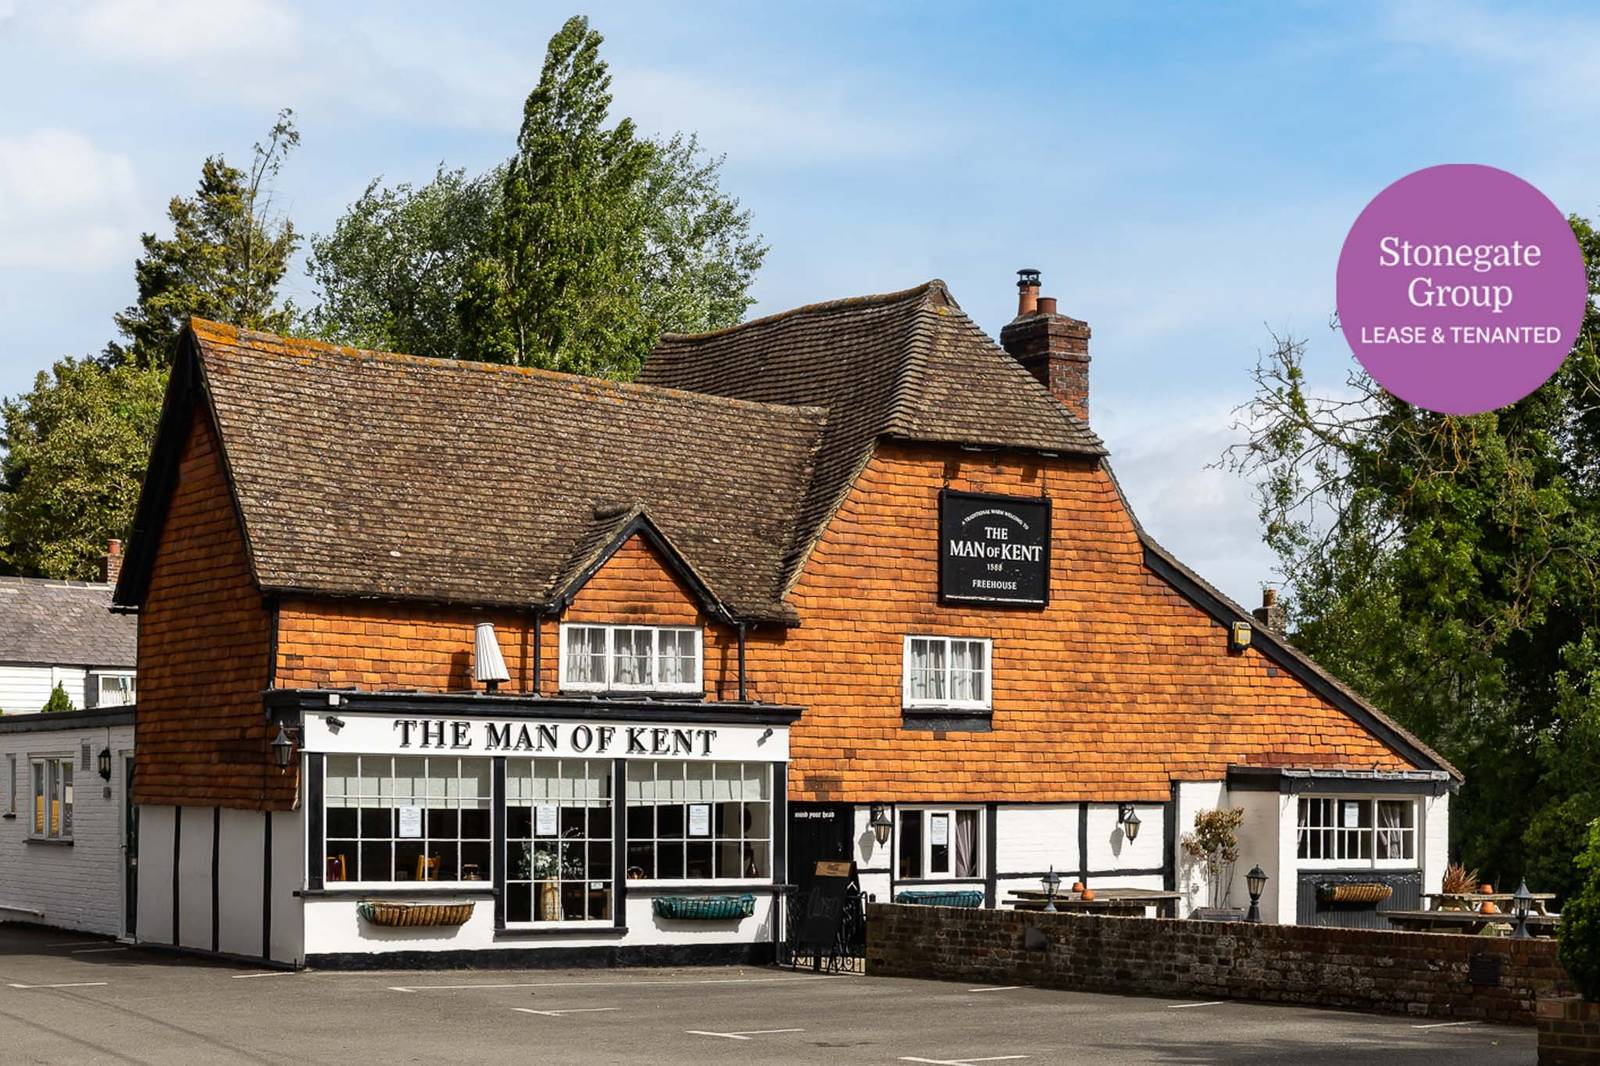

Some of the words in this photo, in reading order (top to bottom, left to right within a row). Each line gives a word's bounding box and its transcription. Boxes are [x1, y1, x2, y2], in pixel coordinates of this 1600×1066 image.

[964, 509, 990, 522] TRADITIONAL
[1004, 511, 1023, 525] WELCOME
[984, 526, 1009, 540] THE
[949, 539, 986, 558] MAN
[986, 546, 1001, 558] OF
[1001, 543, 1043, 562] KENT
[972, 579, 1017, 590] FREEHOUSE
[393, 719, 472, 750] THE
[484, 722, 560, 752] MAN
[570, 724, 616, 754] OF
[625, 726, 717, 757] KENT
